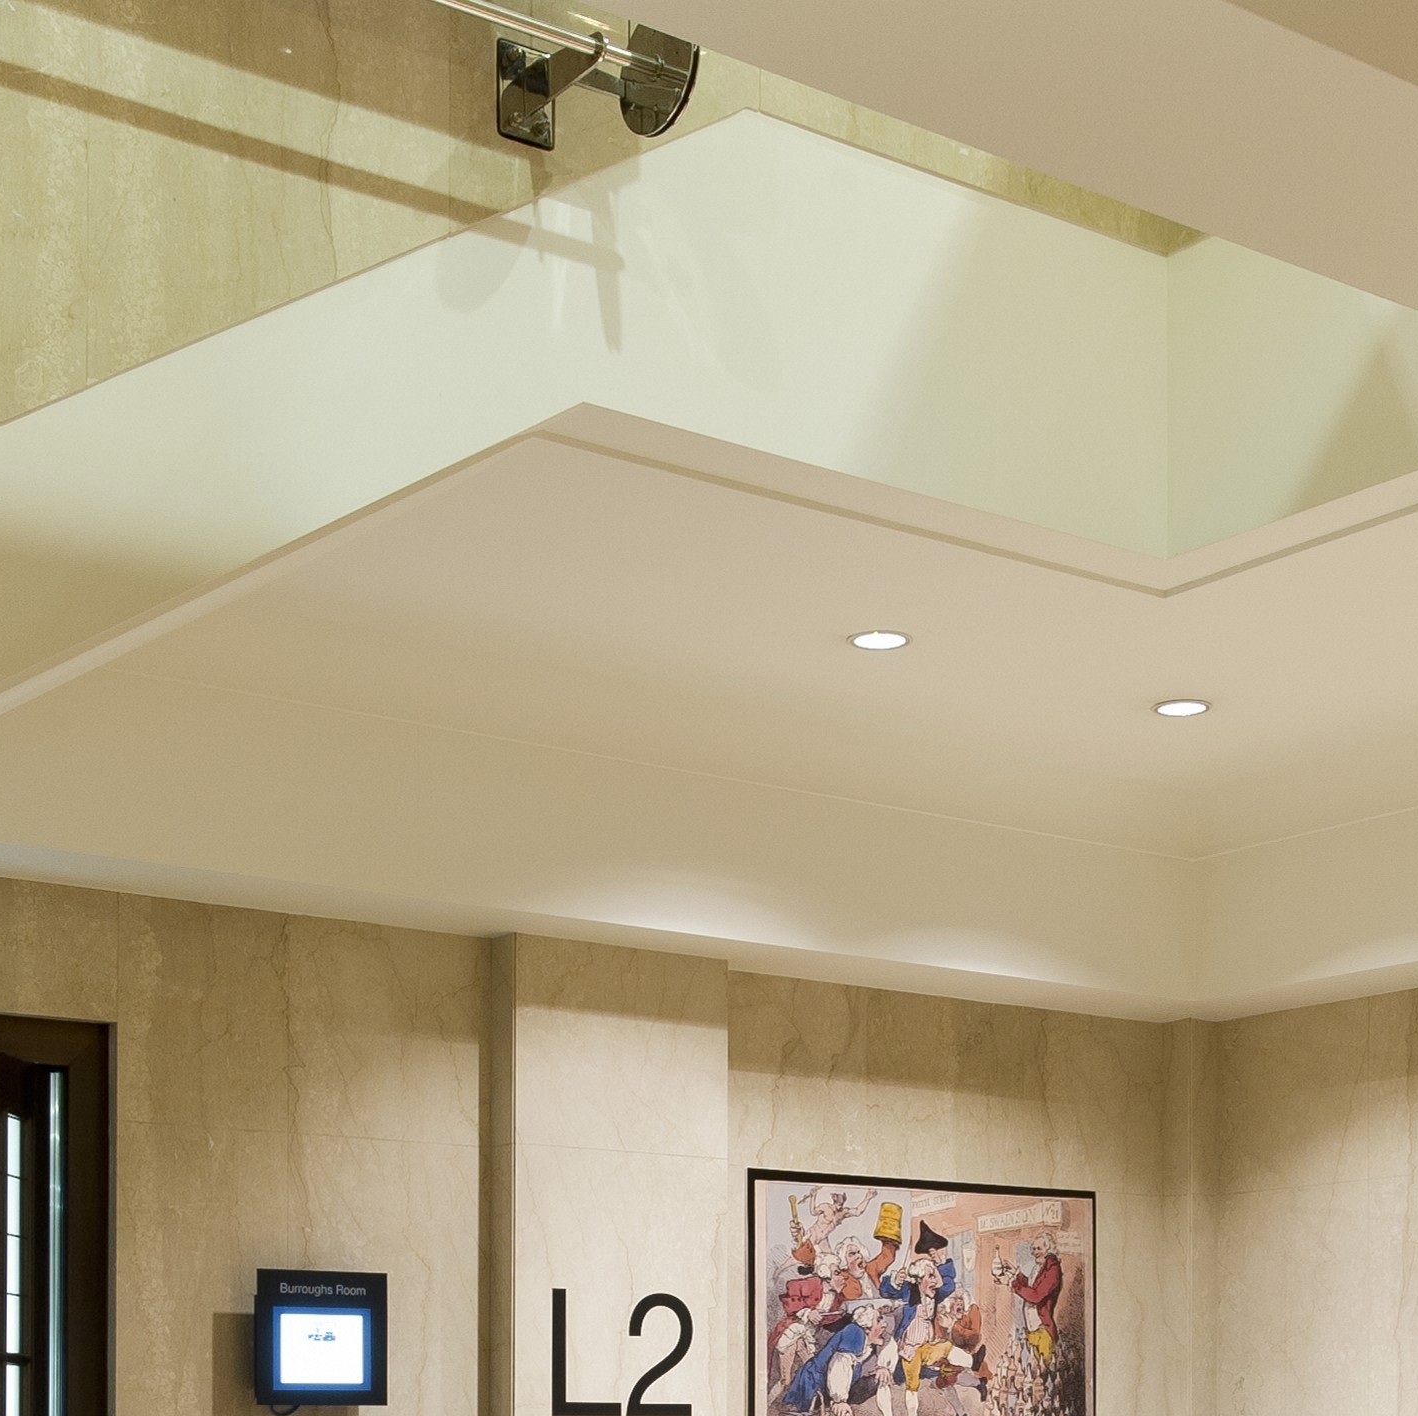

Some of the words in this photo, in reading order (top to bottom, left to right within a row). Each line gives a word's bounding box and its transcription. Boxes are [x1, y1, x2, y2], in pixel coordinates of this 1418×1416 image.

[279, 1282, 333, 1297] Burroughs
[335, 1284, 367, 1296] Room
[552, 1288, 693, 1416] L2
